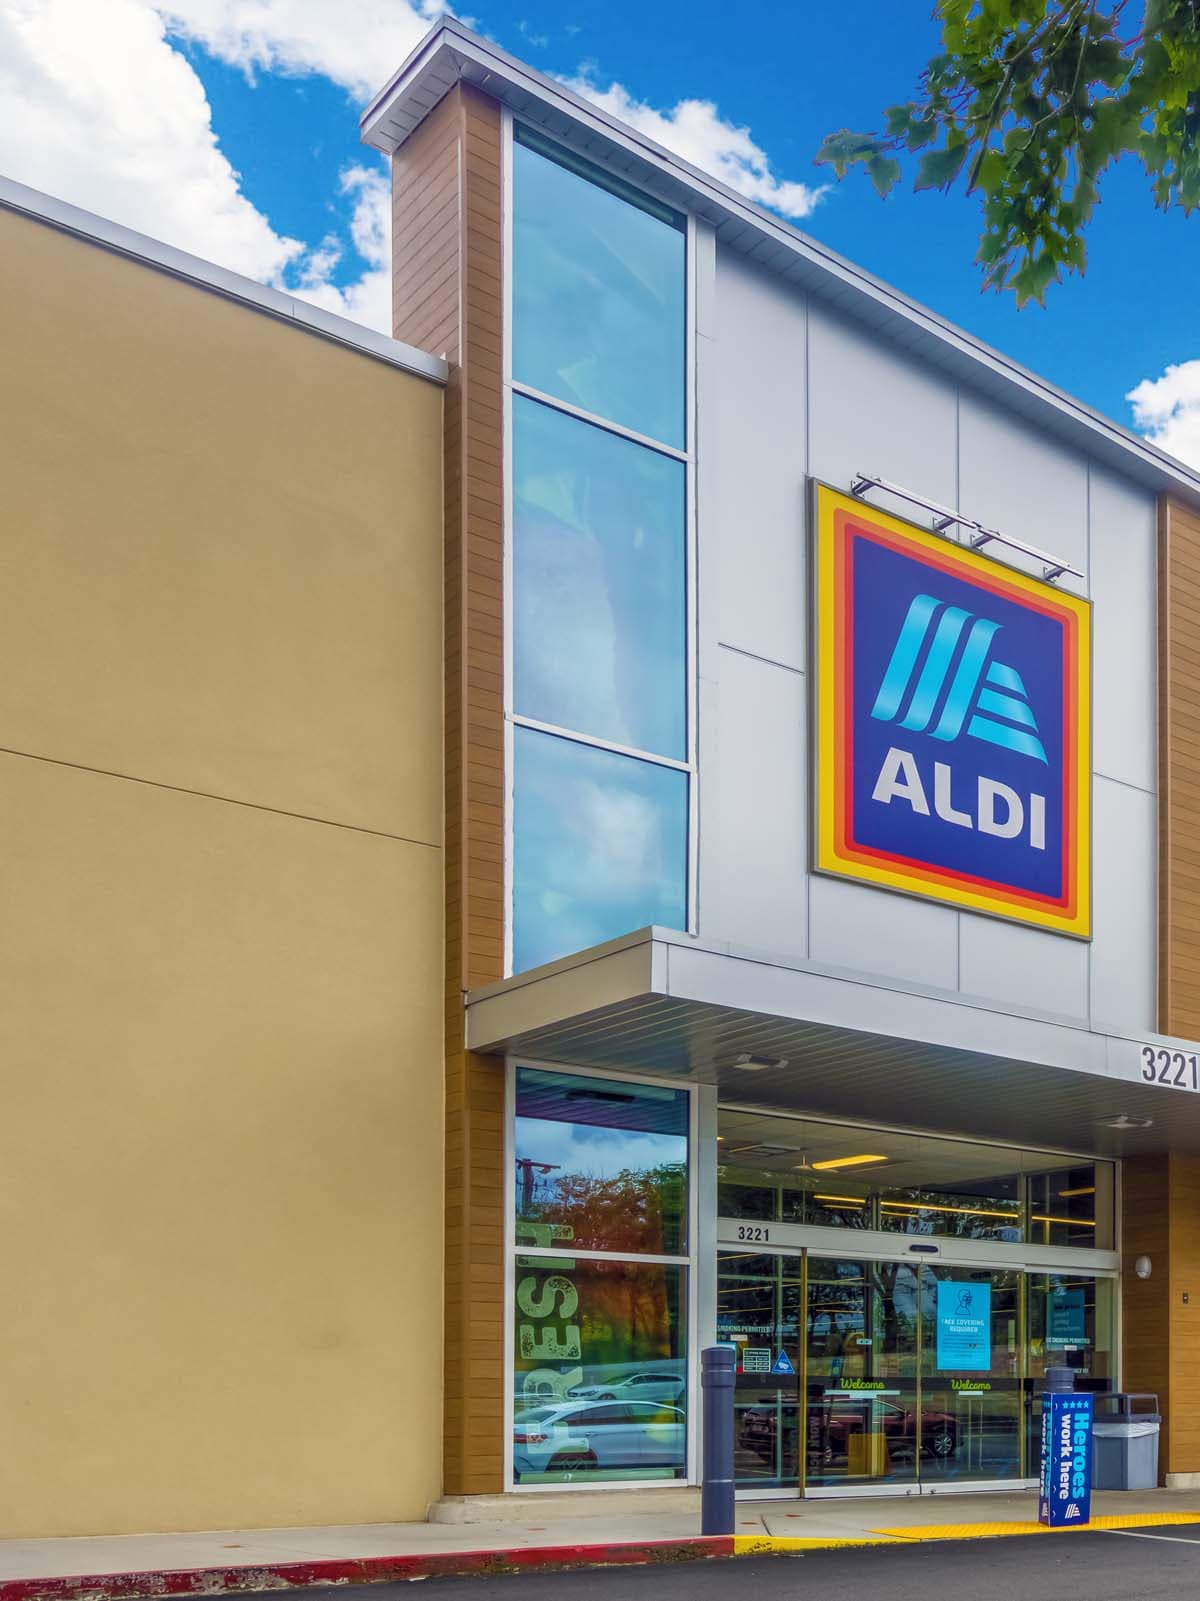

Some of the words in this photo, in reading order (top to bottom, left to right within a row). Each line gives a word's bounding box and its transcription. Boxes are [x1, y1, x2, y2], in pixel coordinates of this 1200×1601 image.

[872, 746, 1046, 850] ALDI
[1142, 1047, 1198, 1090] 3221
[738, 1226, 769, 1241] 3221
[840, 1378, 885, 1389] Welcome
[951, 1379, 991, 1390] Welcome
[1060, 1413, 1073, 1458] work
[1072, 1412, 1090, 1499] Heroes
[1059, 1461, 1073, 1500] here
